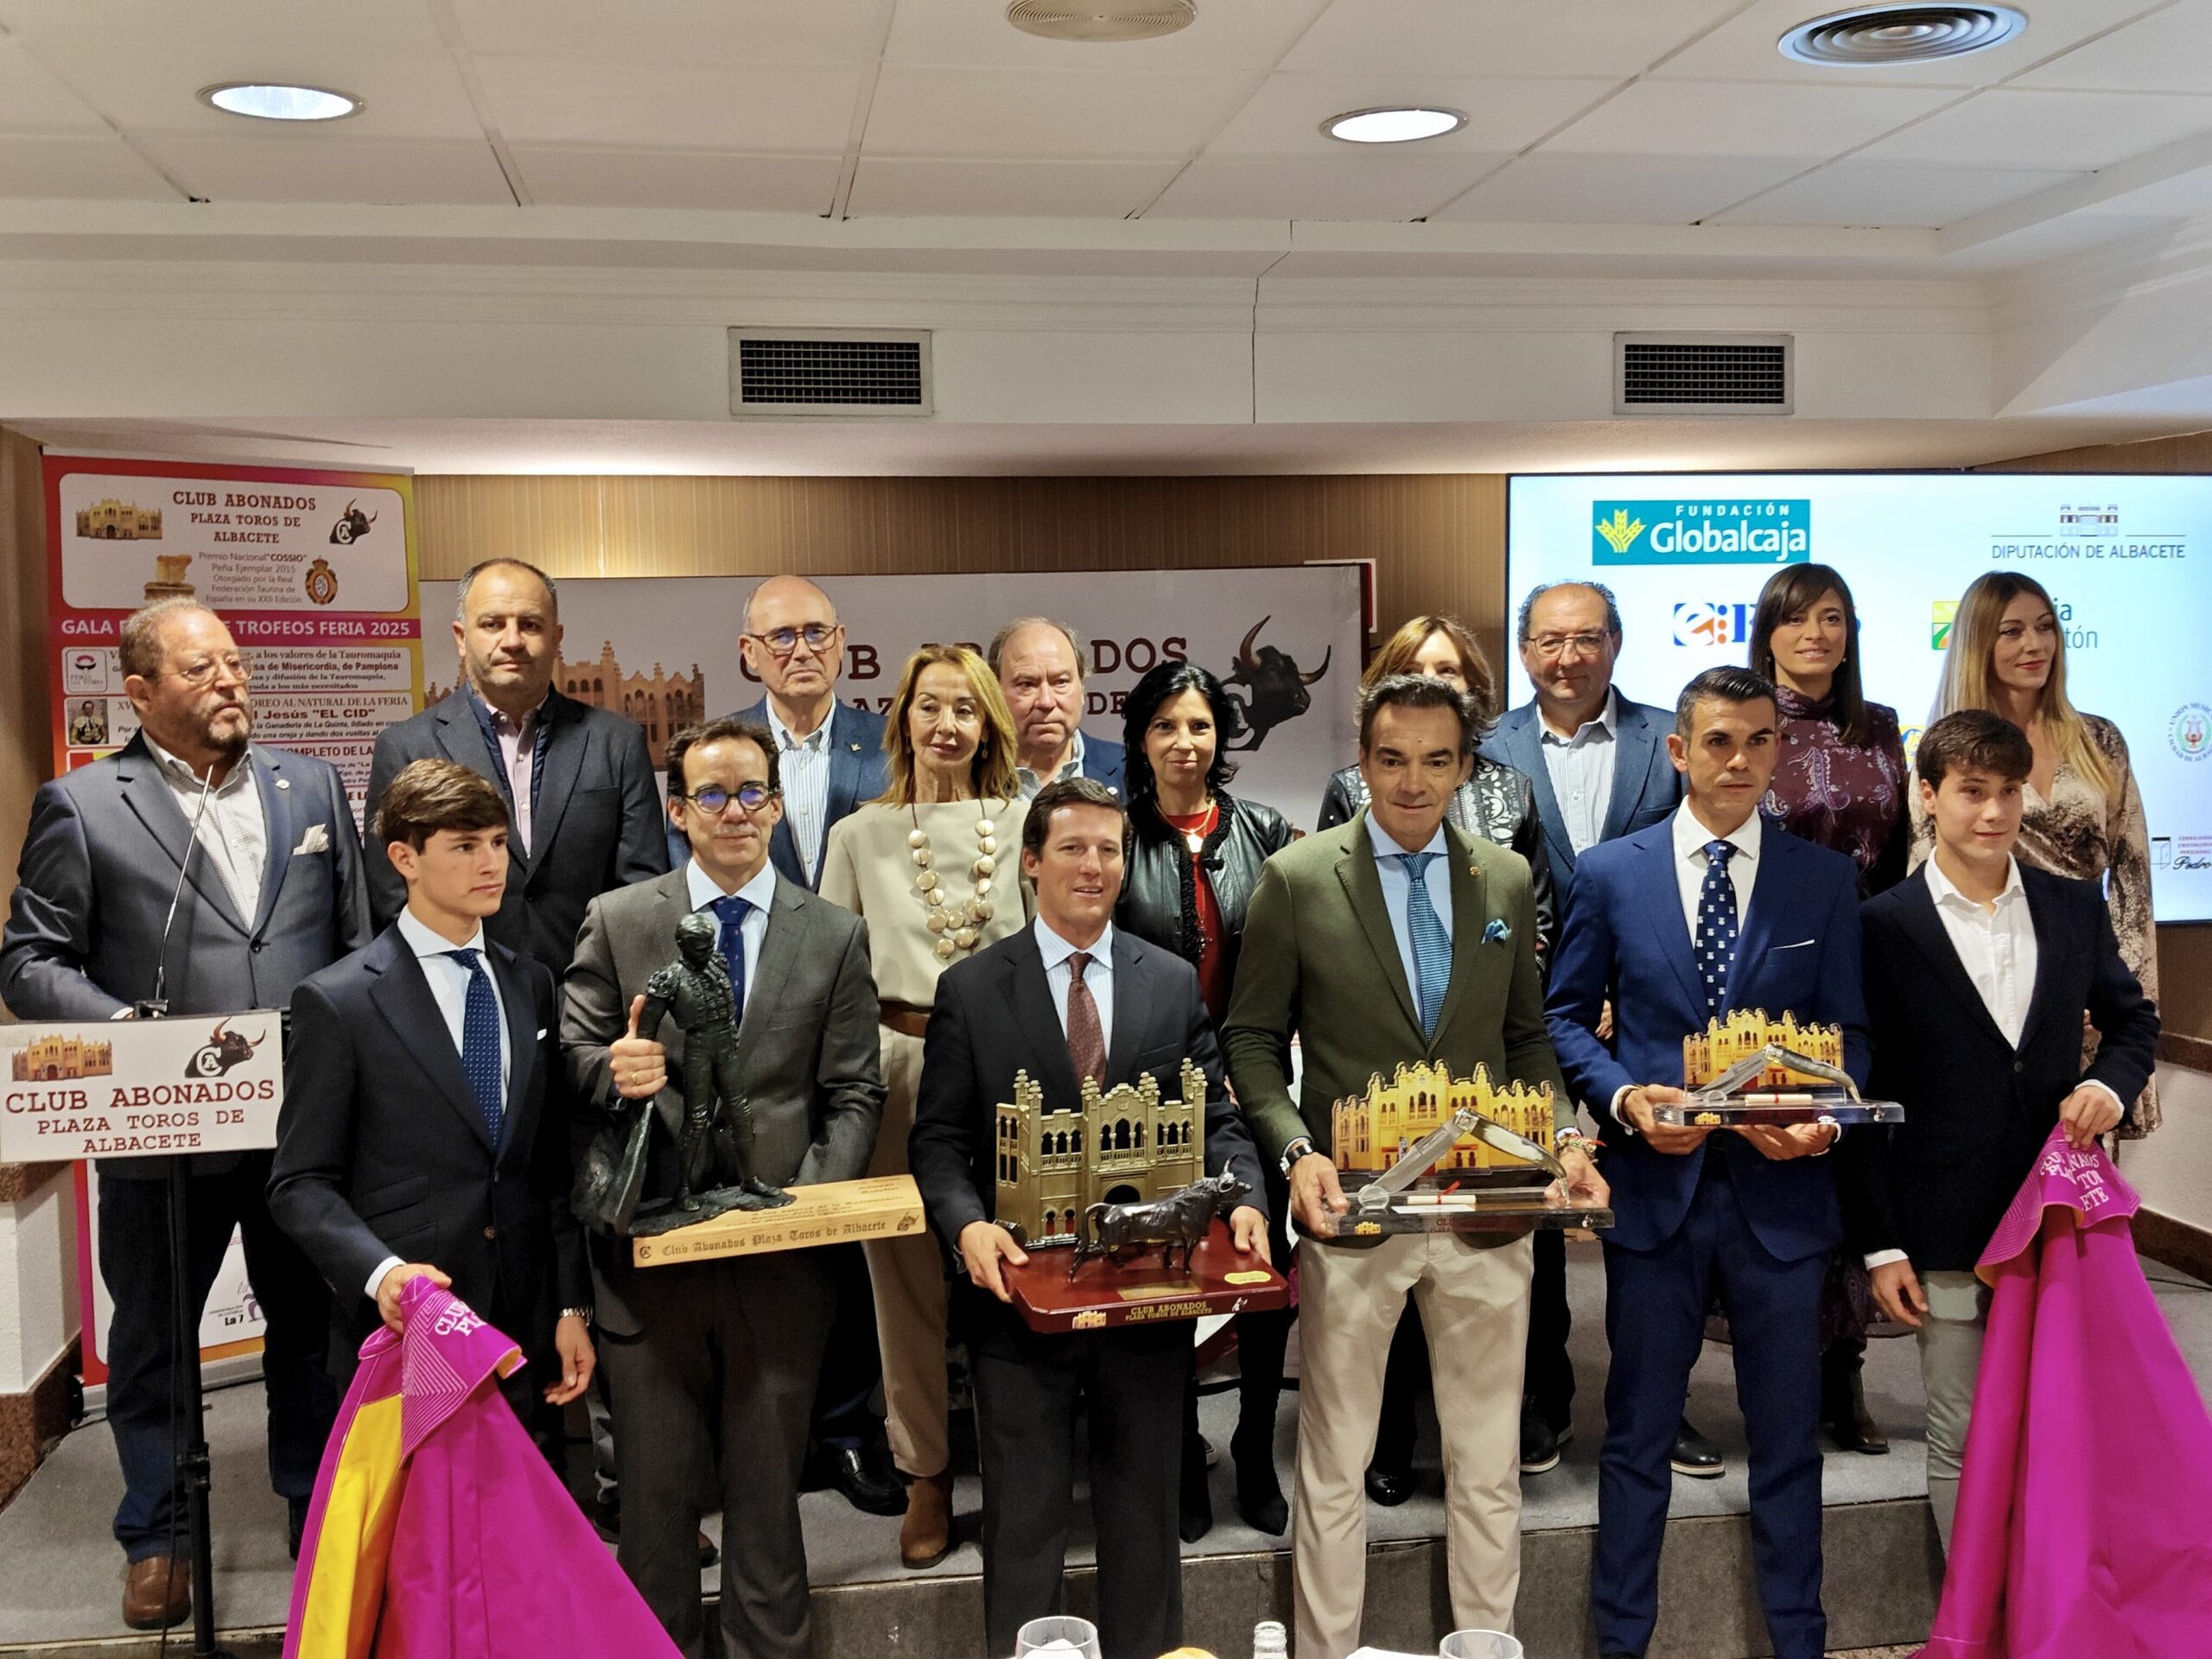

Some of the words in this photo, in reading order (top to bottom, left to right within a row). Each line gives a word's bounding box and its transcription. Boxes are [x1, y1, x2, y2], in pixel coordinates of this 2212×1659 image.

[173, 491, 217, 506] CLUB
[225, 493, 316, 511] ABONADOS
[1675, 502, 1789, 517] FUNDACIÓN
[190, 512, 231, 524] PLAZA
[236, 514, 278, 527] TOROS
[283, 517, 301, 527] DE
[213, 531, 280, 543] ALBACETE
[1649, 519, 1807, 562] Globalcaja
[199, 551, 228, 560] Premio
[230, 551, 266, 562] Nacional
[1992, 543, 2081, 559] DIPUTACIÓN
[2086, 545, 2105, 559] DE
[2109, 544, 2186, 559] ALBACETE
[212, 563, 233, 572] Peña
[235, 563, 273, 574] Ejemplar
[275, 564, 296, 574] 2015
[213, 574, 251, 583] Otorgado
[212, 584, 255, 593] Federación
[206, 594, 233, 604] España
[60, 620, 114, 635] GALA
[235, 620, 315, 635] TROFEOS
[320, 621, 365, 636] FERIA
[370, 622, 410, 636] 2025
[264, 650, 278, 658] los
[280, 650, 315, 659] valores
[315, 650, 327, 658] de
[329, 650, 337, 658] la
[339, 650, 401, 662] Tauromaquia
[268, 662, 278, 671] de
[282, 662, 340, 671] Misericordia,
[342, 662, 353, 671] de
[355, 662, 399, 672] Pamplona
[251, 698, 280, 707] OREO
[283, 698, 296, 707] AL
[297, 698, 346, 707] NATURAL
[347, 697, 363, 707] DE
[364, 697, 376, 706] LA
[378, 696, 408, 706] FERIA
[264, 710, 308, 719] Jesús
[313, 709, 339, 719] "EL
[343, 709, 375, 718] CID"
[342, 747, 358, 755] DE
[359, 747, 373, 755] LA
[6, 1090, 88, 1114] CLUB
[110, 1079, 275, 1108] ABONADOS
[37, 1117, 111, 1135] PLAZA
[127, 1112, 200, 1129] TOROS
[215, 1109, 245, 1124] DE
[82, 1133, 201, 1153] ALBACETE
[662, 1244, 688, 1256] Club
[693, 1237, 746, 1253] Abonados
[752, 1233, 783, 1247] Plaza
[790, 1230, 822, 1241] Toros
[826, 1227, 837, 1236] de
[843, 1222, 887, 1236] Albacete
[1131, 1306, 1154, 1315] CLUB
[1158, 1301, 1207, 1313] ABONADOS
[225, 1317, 237, 1326] La
[238, 1313, 244, 1324] 7
